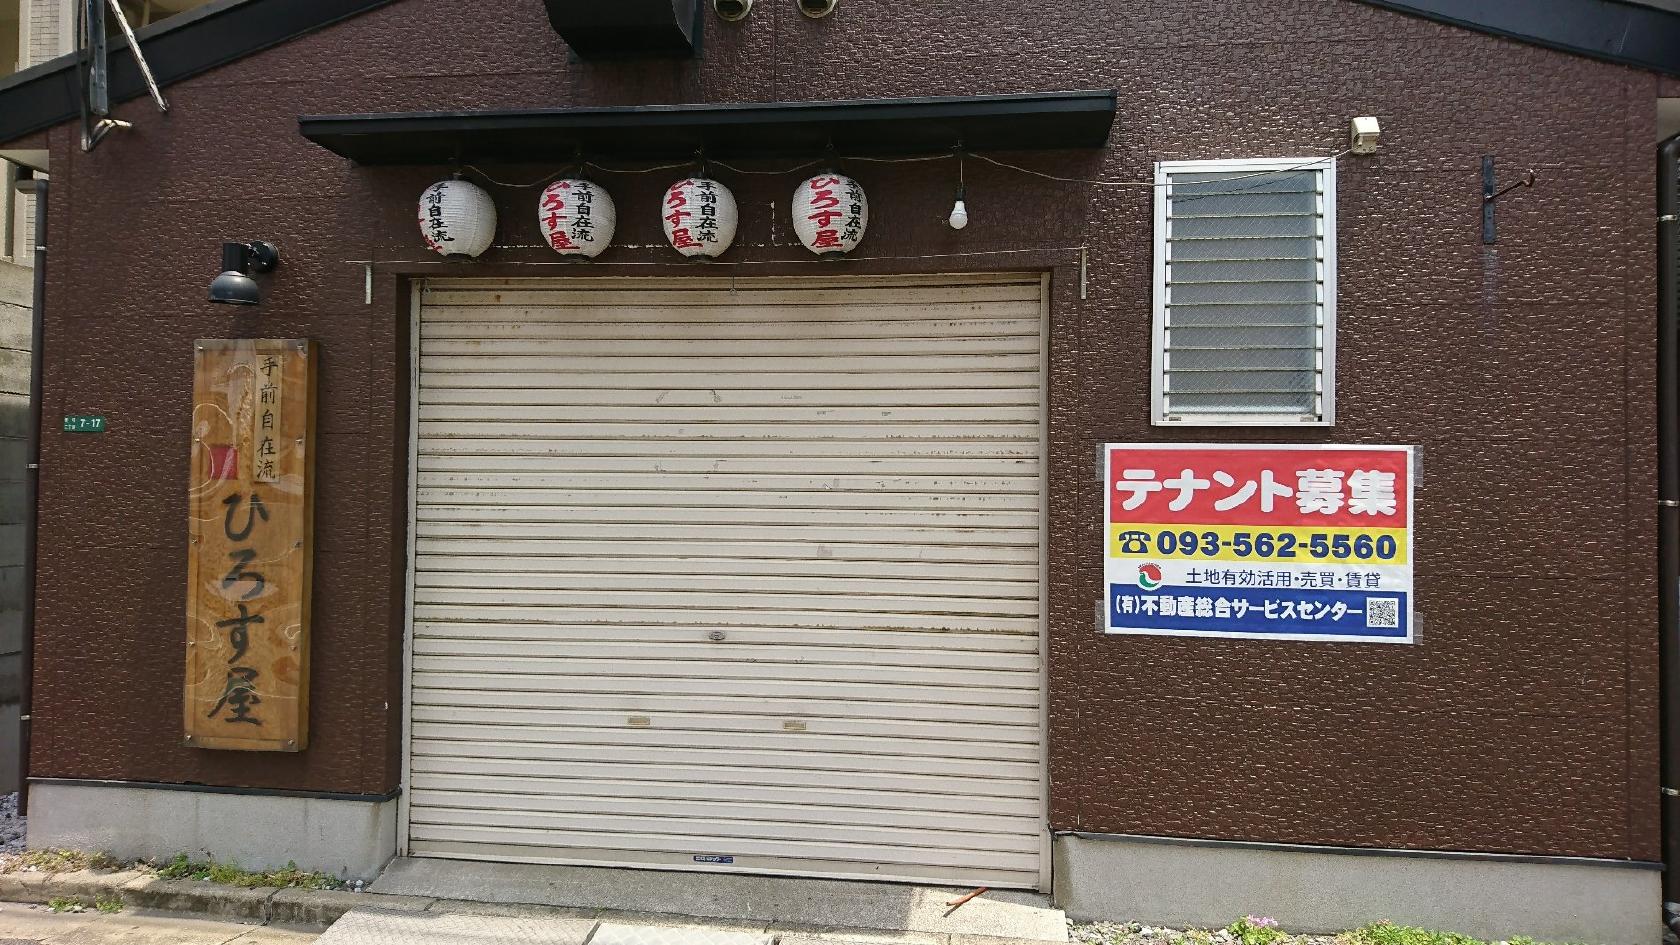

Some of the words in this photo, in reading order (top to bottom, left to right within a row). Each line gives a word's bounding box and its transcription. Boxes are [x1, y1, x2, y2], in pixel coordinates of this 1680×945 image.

[426, 182, 455, 242] 手前自在流
[542, 181, 580, 250] ひろす屋
[571, 183, 595, 242] 手前自在流
[695, 182, 718, 243] 手前自在流
[808, 177, 843, 248] ひろす屋
[840, 180, 862, 242] 手前自在流
[80, 419, 101, 428] 7-17
[256, 357, 279, 479] 手前自在流
[1115, 469, 1397, 516] テナント募集
[1156, 531, 1397, 560] 093-562-5560
[1115, 594, 1363, 622] (有)不動産総合サービスセンター
[1186, 567, 1381, 589] 土地有効活用・売買・賃貸
[207, 491, 270, 726] ひろす屋
